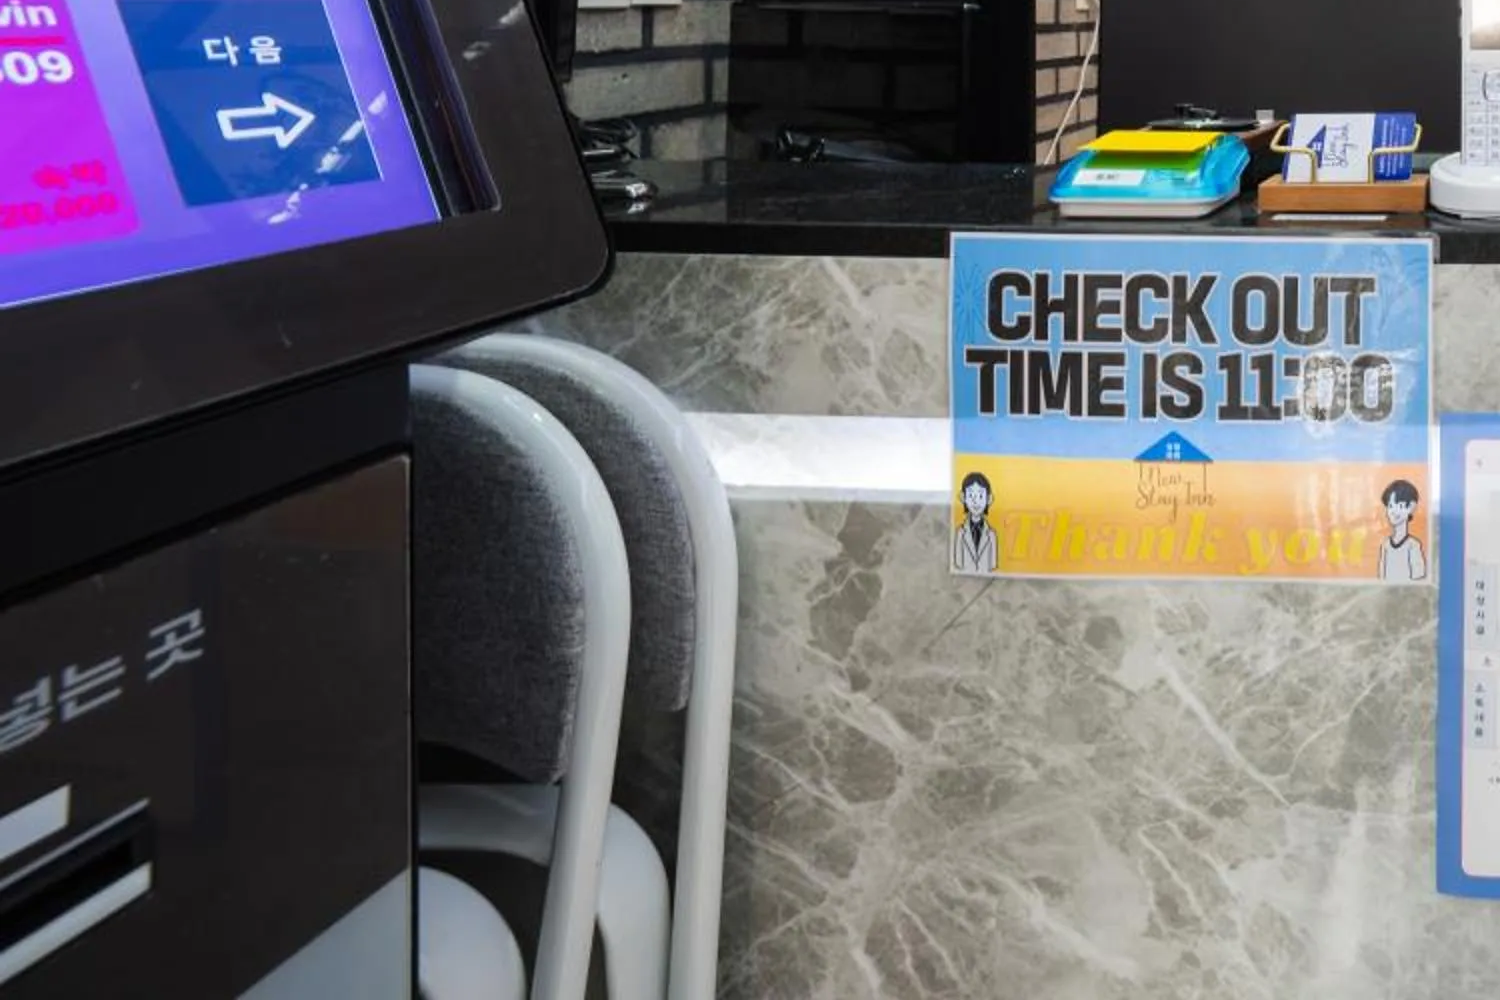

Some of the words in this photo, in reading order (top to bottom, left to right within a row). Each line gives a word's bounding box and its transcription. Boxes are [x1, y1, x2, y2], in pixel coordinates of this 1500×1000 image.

[0, 50, 75, 86] 09
[987, 271, 1218, 346] CHECK
[1231, 273, 1377, 347] OUT
[965, 348, 1127, 418] TIME
[1141, 351, 1205, 420] IS
[1216, 352, 1394, 422] 11:00
[1004, 510, 1226, 565] Thank
[1241, 525, 1369, 575] you
[145, 608, 205, 681] 곳
